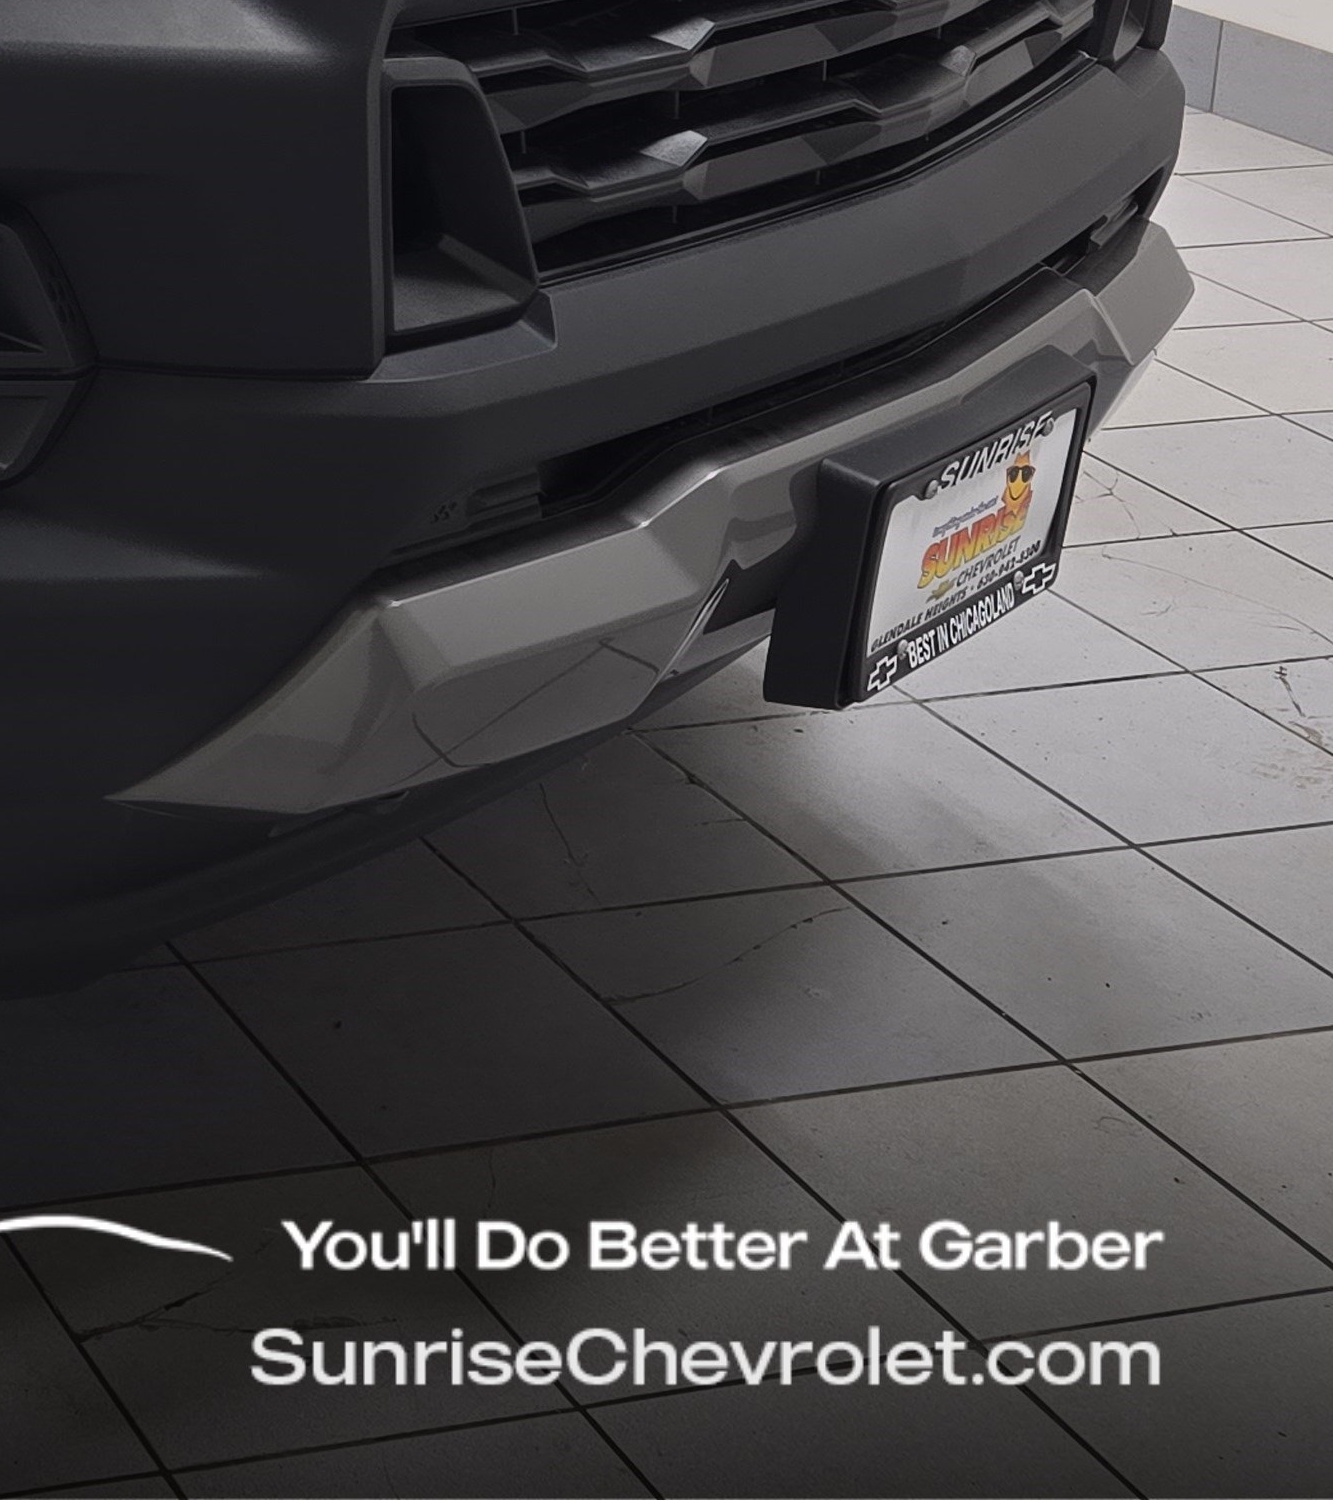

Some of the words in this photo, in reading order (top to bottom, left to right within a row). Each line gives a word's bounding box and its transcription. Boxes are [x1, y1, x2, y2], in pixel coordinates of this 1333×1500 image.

[940, 410, 1053, 489] SUNRISE
[917, 490, 1032, 589] SUNRISE
[956, 535, 1021, 587] CHEVROLET
[870, 612, 923, 652] GLENDALE
[925, 586, 966, 621] HEIGHTS
[905, 631, 936, 669] BEST
[936, 620, 949, 651] IN
[949, 582, 1015, 644] CHICAGOLAND
